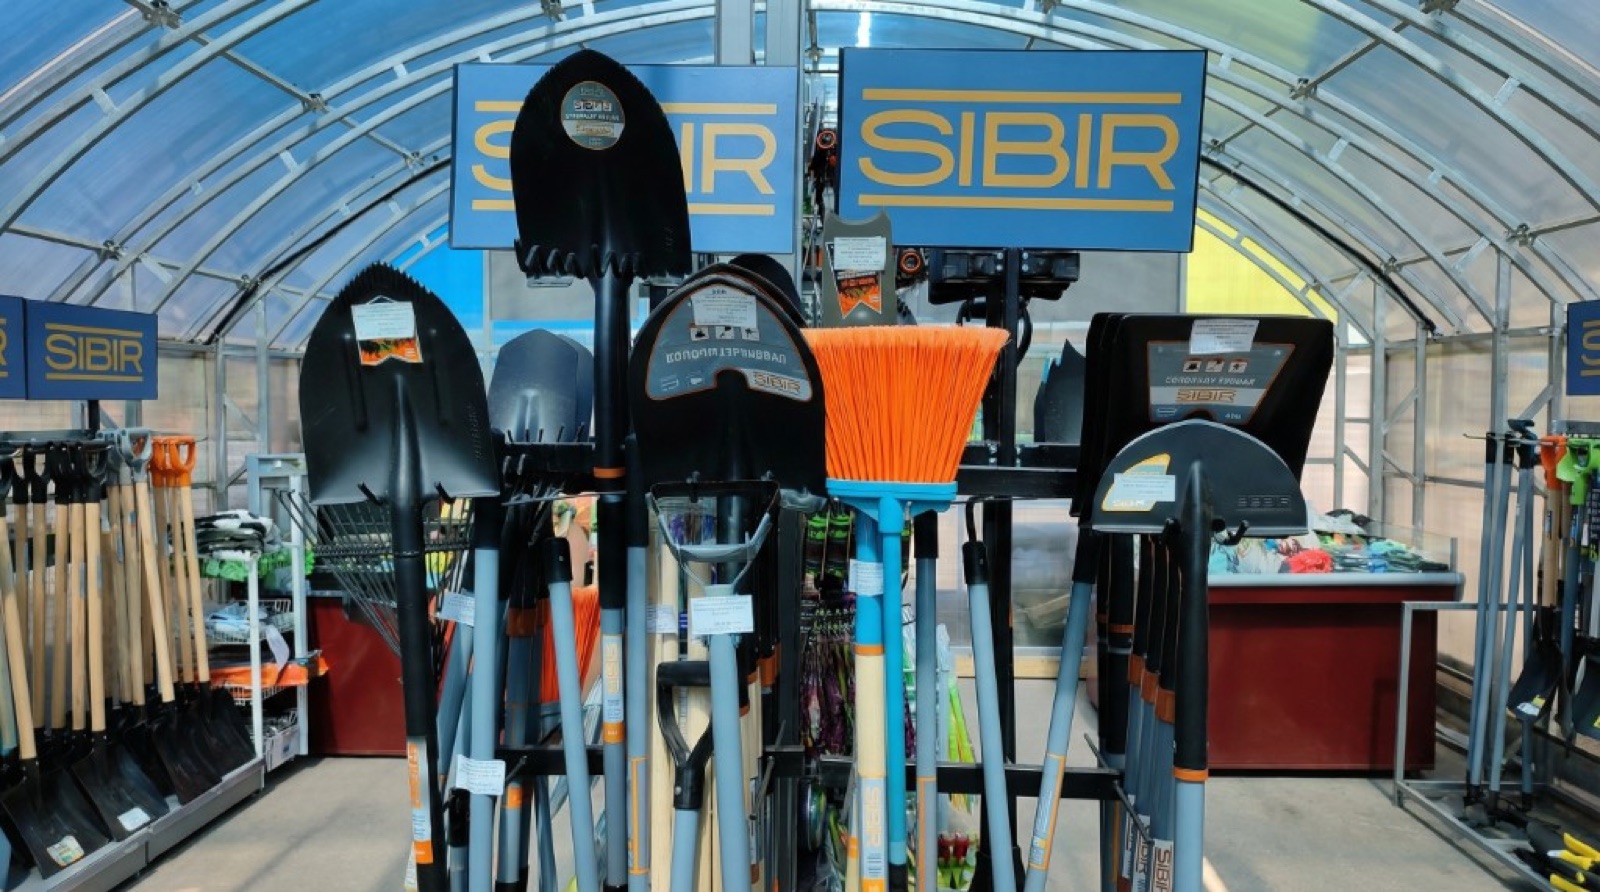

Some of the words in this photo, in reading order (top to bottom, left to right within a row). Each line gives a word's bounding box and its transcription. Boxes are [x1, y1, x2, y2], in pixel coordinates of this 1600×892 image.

[471, 119, 777, 195] SIR
[858, 109, 1180, 190] SIBIR
[45, 333, 143, 373] SIBIR
